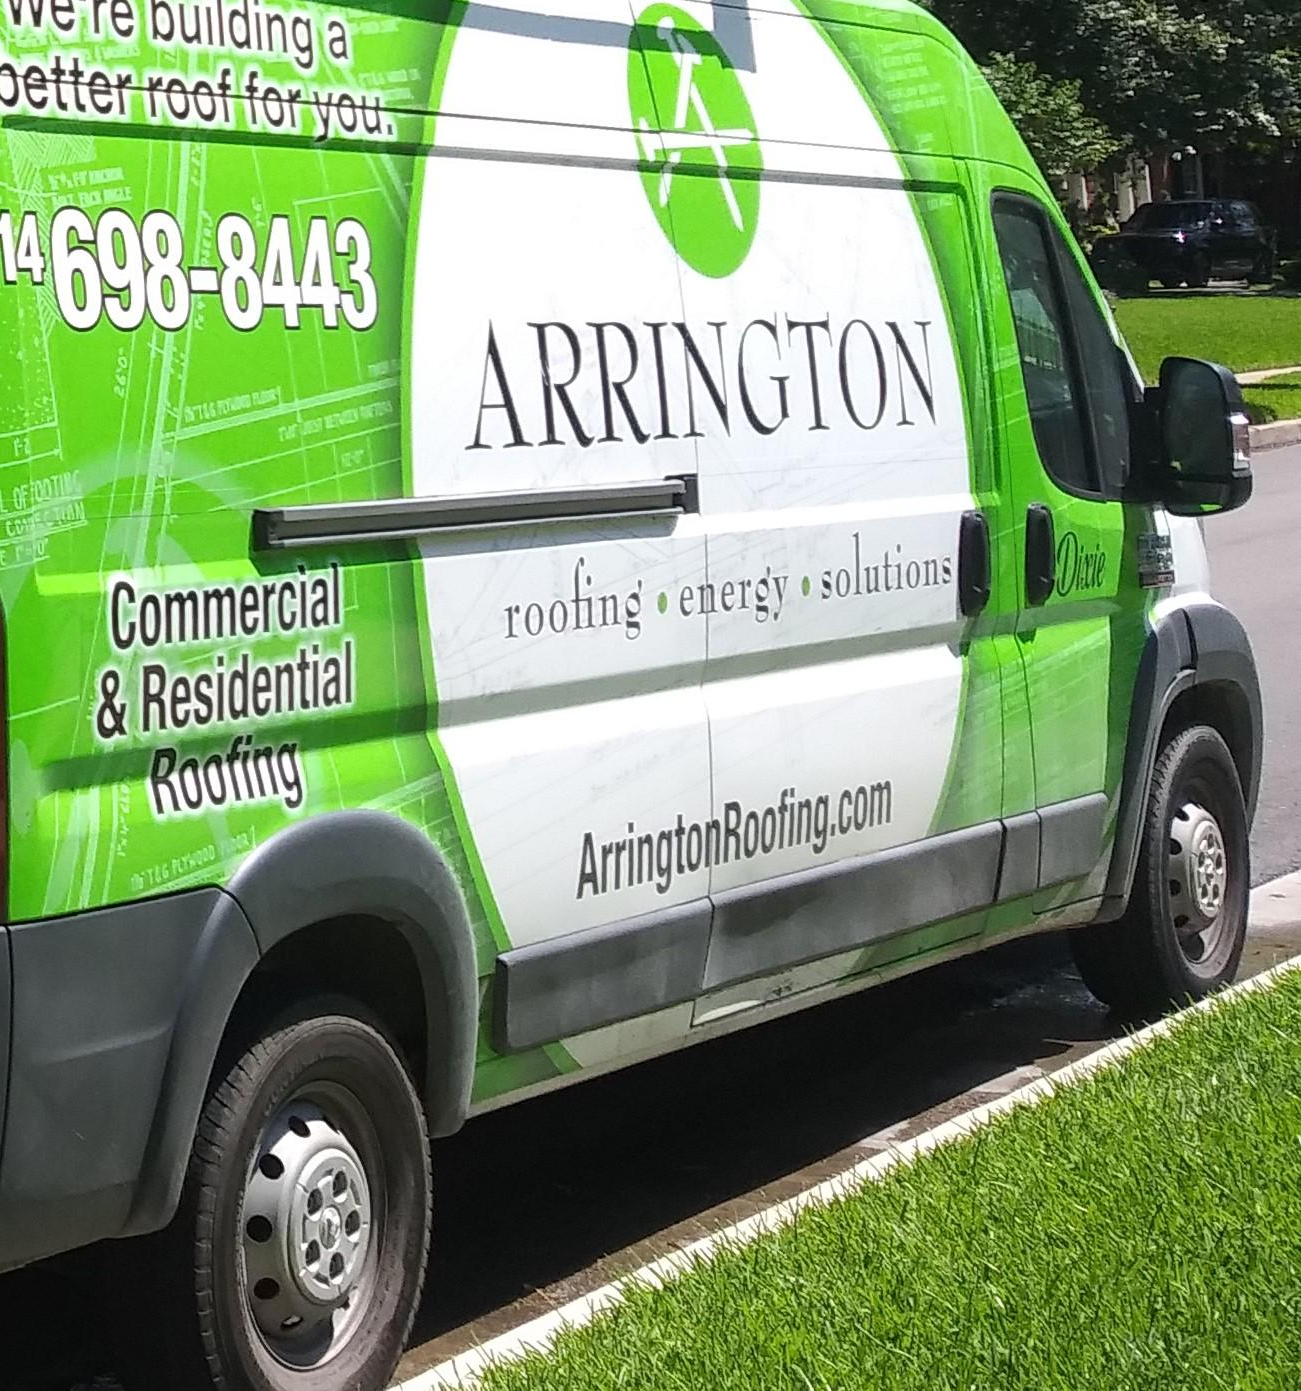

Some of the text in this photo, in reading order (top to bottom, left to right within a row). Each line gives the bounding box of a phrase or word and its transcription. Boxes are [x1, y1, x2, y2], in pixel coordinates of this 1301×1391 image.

[327, 19, 349, 60] a
[148, 68, 232, 123] roof
[243, 70, 302, 129] for
[312, 92, 394, 142] you.
[49, 206, 379, 333] 698-8443
[465, 313, 936, 450] ARRINGTON
[110, 563, 340, 650] Commercial
[503, 532, 953, 642] roofing energy solutions
[1057, 531, 1106, 597] Dixie
[96, 642, 354, 739] & Residential
[150, 735, 301, 816] Roofing
[575, 776, 893, 900] ArringtonRoofing.com
